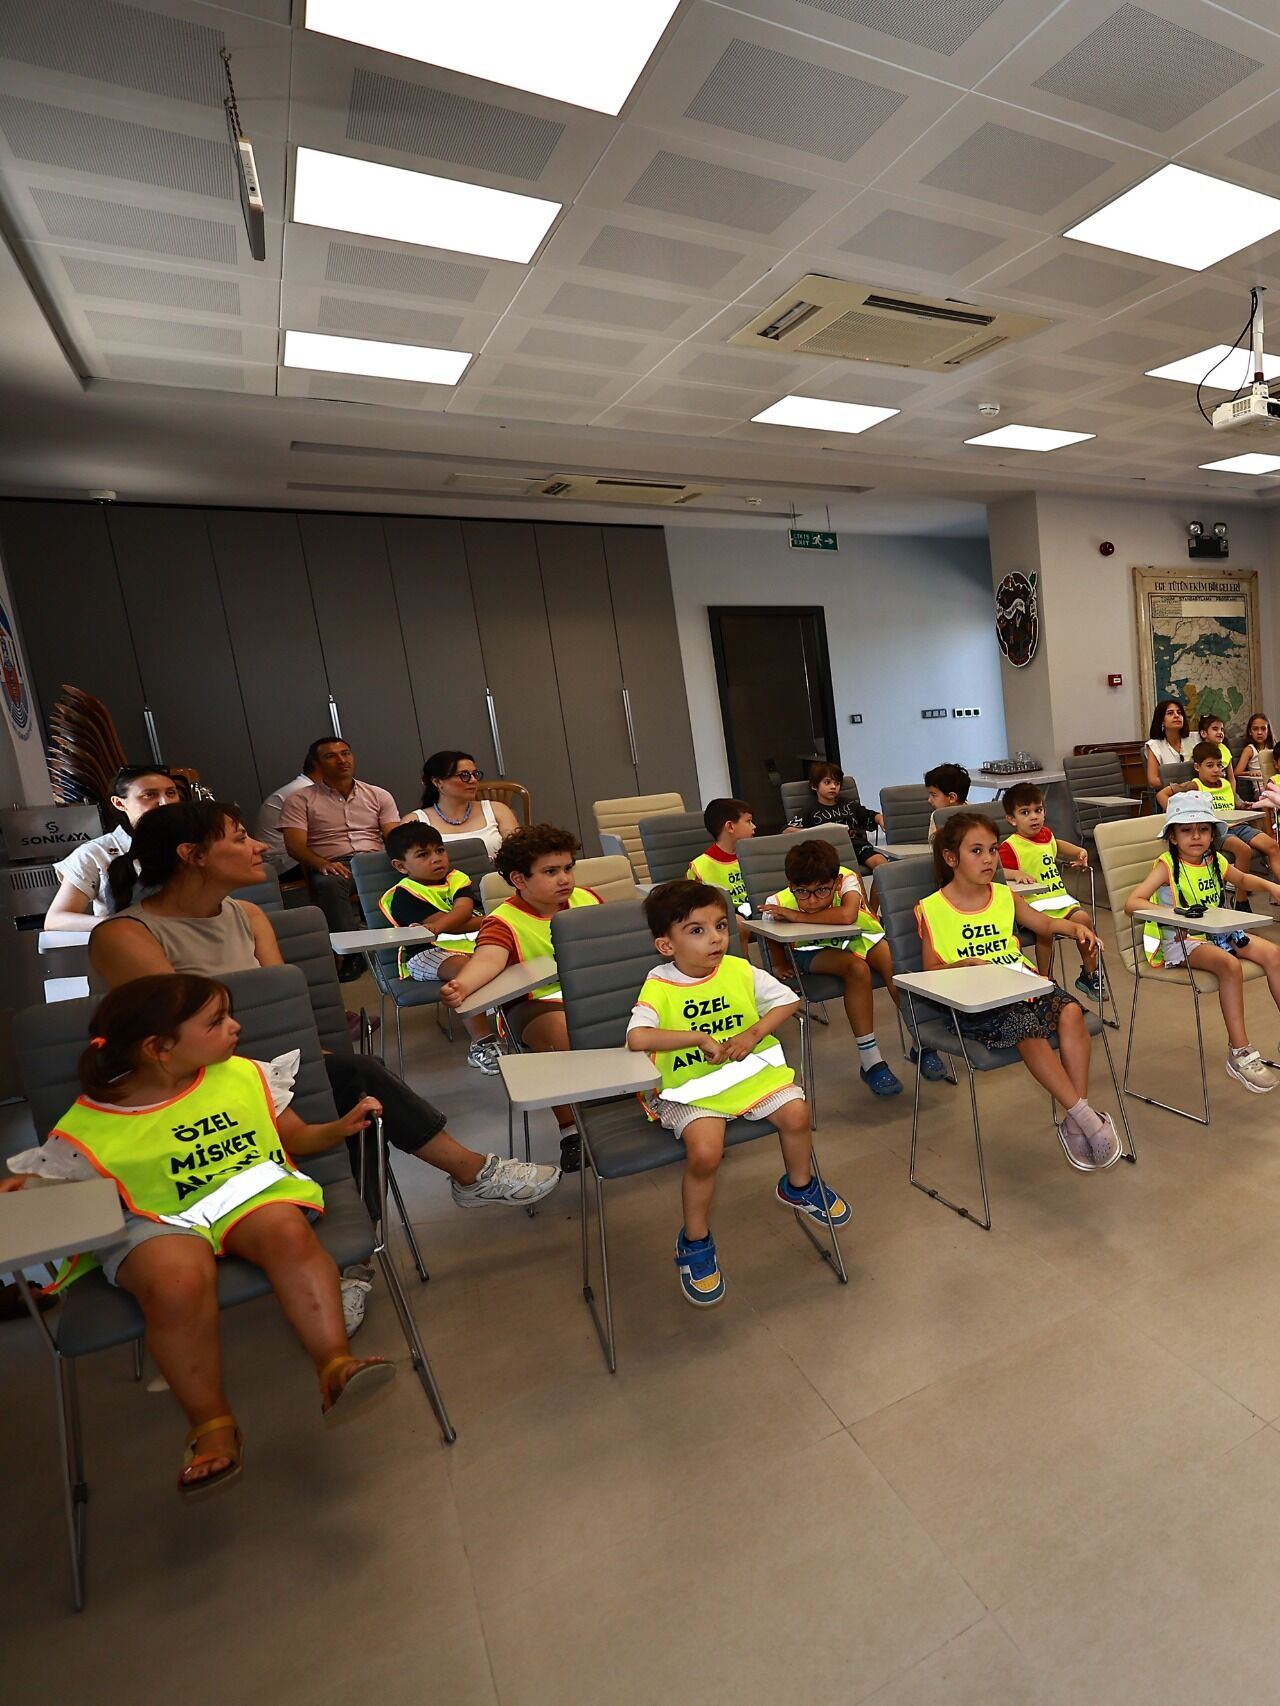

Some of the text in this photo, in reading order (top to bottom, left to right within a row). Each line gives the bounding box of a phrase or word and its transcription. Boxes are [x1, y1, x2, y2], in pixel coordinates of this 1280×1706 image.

[1168, 581, 1188, 591] TÜTÜN
[21, 832, 92, 846] SONKAYA
[962, 924, 1000, 940] ÖZEL
[957, 939, 1008, 958] MİSKET
[683, 996, 730, 1019] ÖZEL
[691, 1014, 744, 1035] İSKET
[171, 1111, 239, 1142] ÖZEL
[171, 1130, 256, 1175] MİSKET
